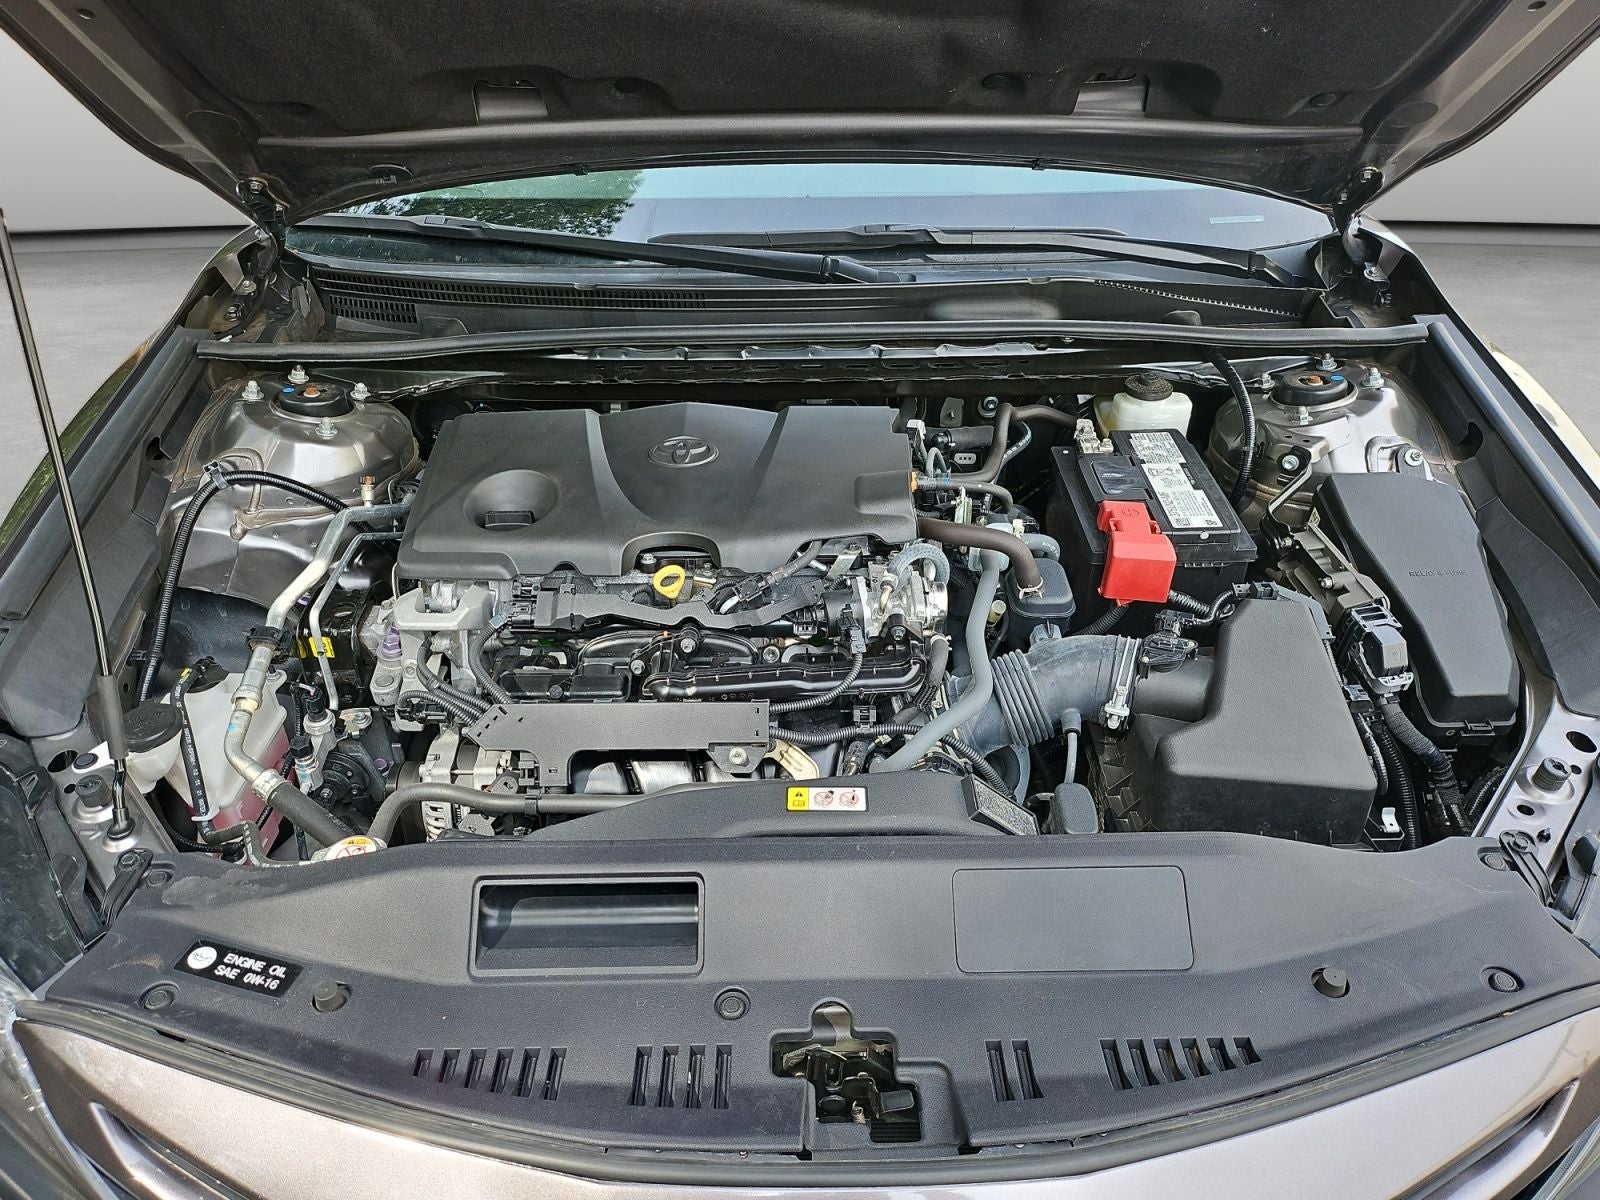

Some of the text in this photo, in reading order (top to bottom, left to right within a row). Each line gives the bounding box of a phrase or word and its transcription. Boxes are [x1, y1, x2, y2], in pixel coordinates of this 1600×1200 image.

[1408, 569, 1435, 577] RELAY
[214, 964, 280, 990] SAE 0W-16
[223, 952, 287, 979] ENGINE OIL
